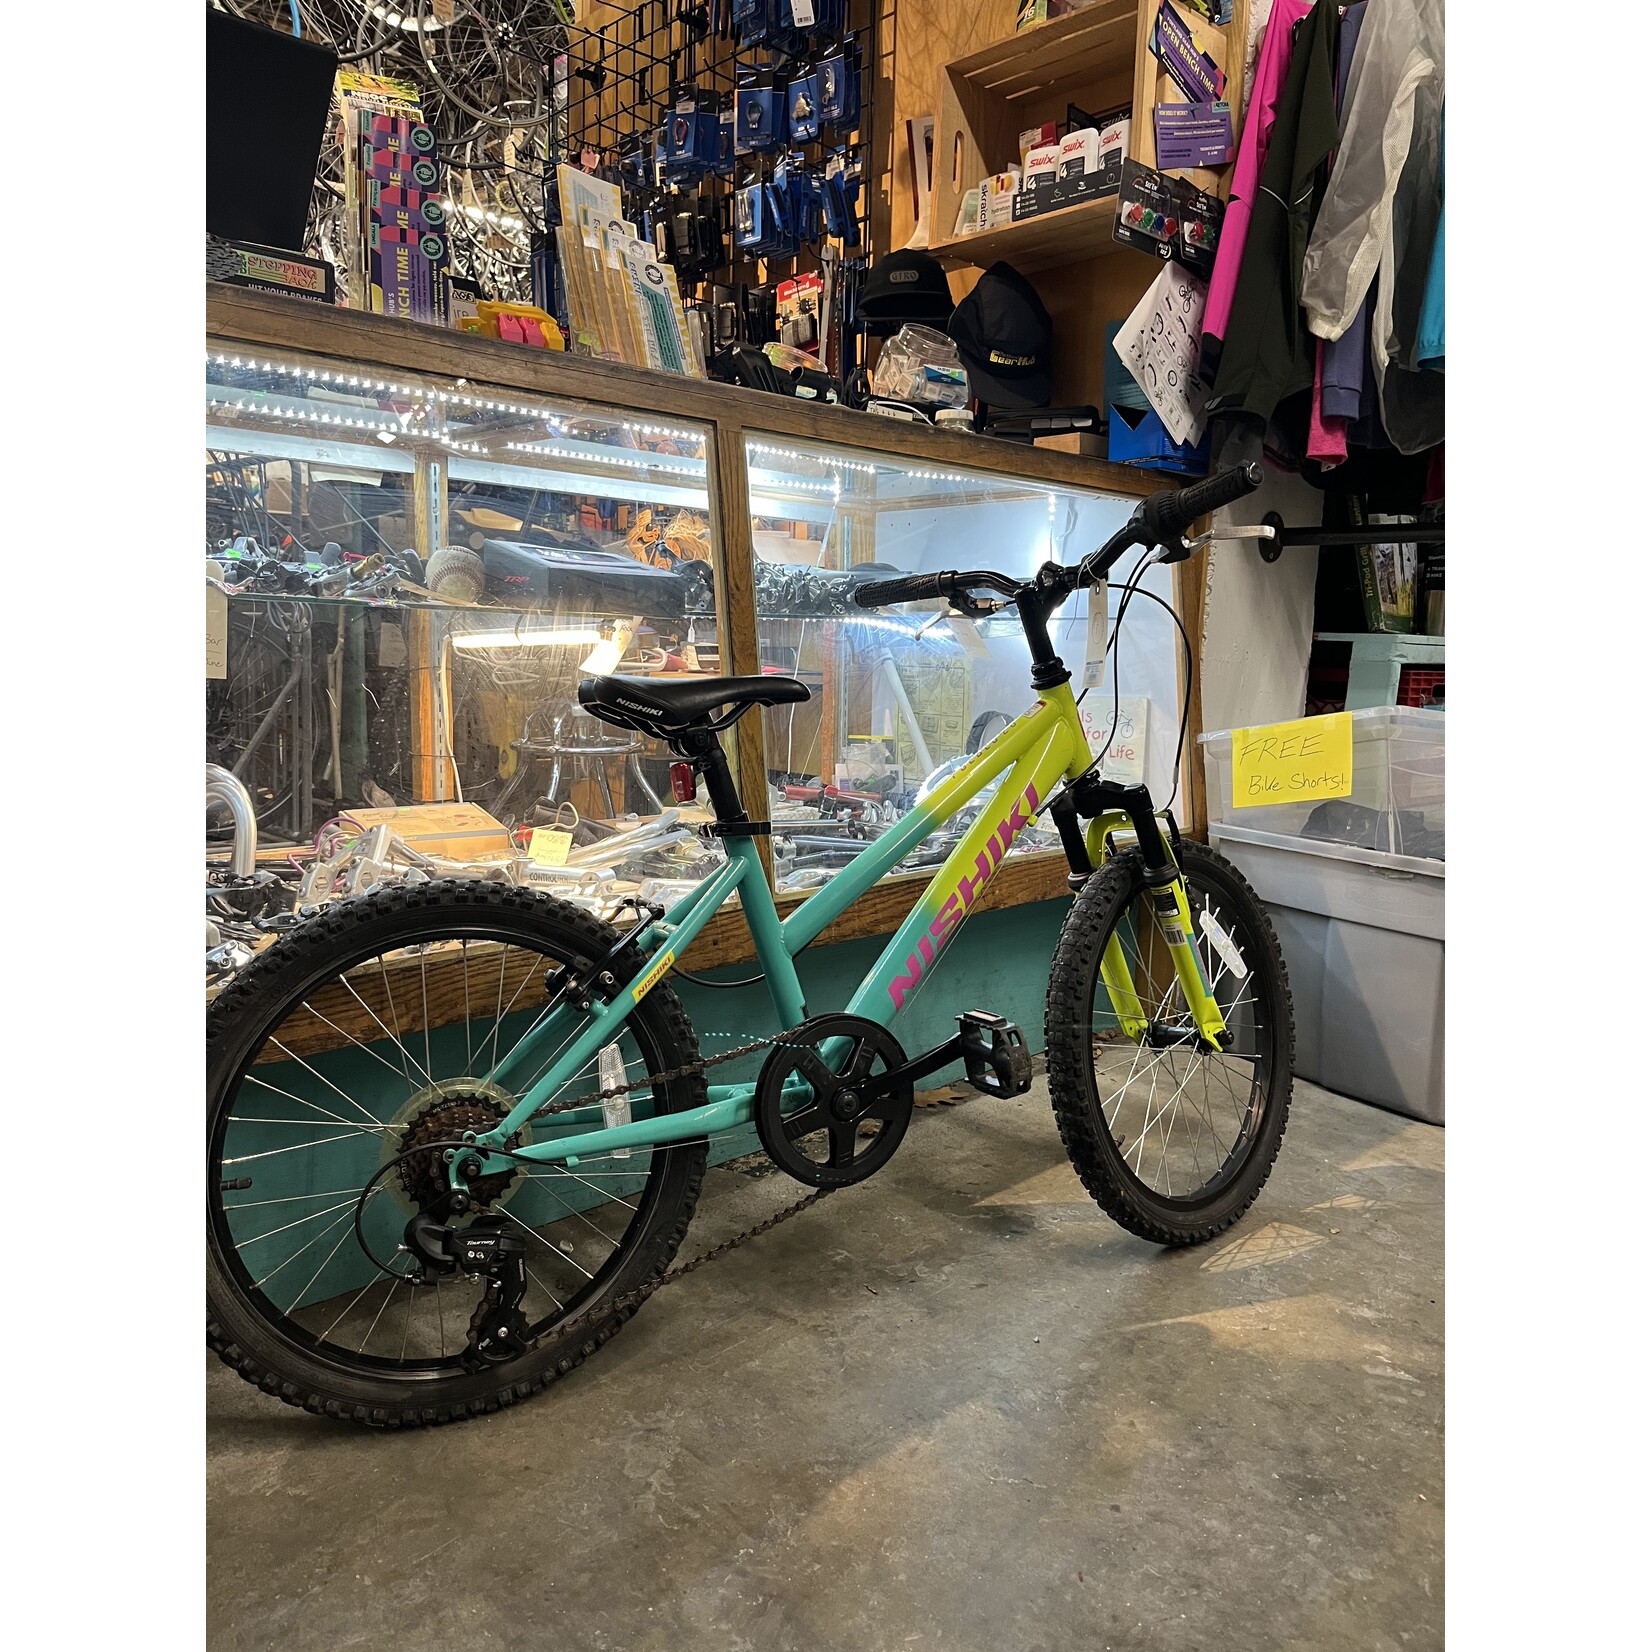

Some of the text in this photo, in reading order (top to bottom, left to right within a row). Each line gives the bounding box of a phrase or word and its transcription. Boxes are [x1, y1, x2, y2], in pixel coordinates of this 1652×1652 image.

[1162, 21, 1180, 47] OPEN
[1179, 44, 1200, 75] BENCH
[1199, 70, 1215, 94] TIME
[1027, 176, 1037, 190] 4
[1060, 163, 1068, 179] 4
[396, 247, 411, 319] NCH TIME
[891, 271, 918, 281] GIRO
[1362, 567, 1374, 598] Tri-Pod
[616, 698, 664, 716] NISHIKI
[1086, 726, 1108, 740] for
[1109, 745, 1135, 760] Life
[1240, 734, 1324, 766] FREE
[1248, 771, 1345, 795] Bike Shorts!
[887, 782, 1039, 1012] NISHIKI
[637, 956, 671, 997] NISHIKI
